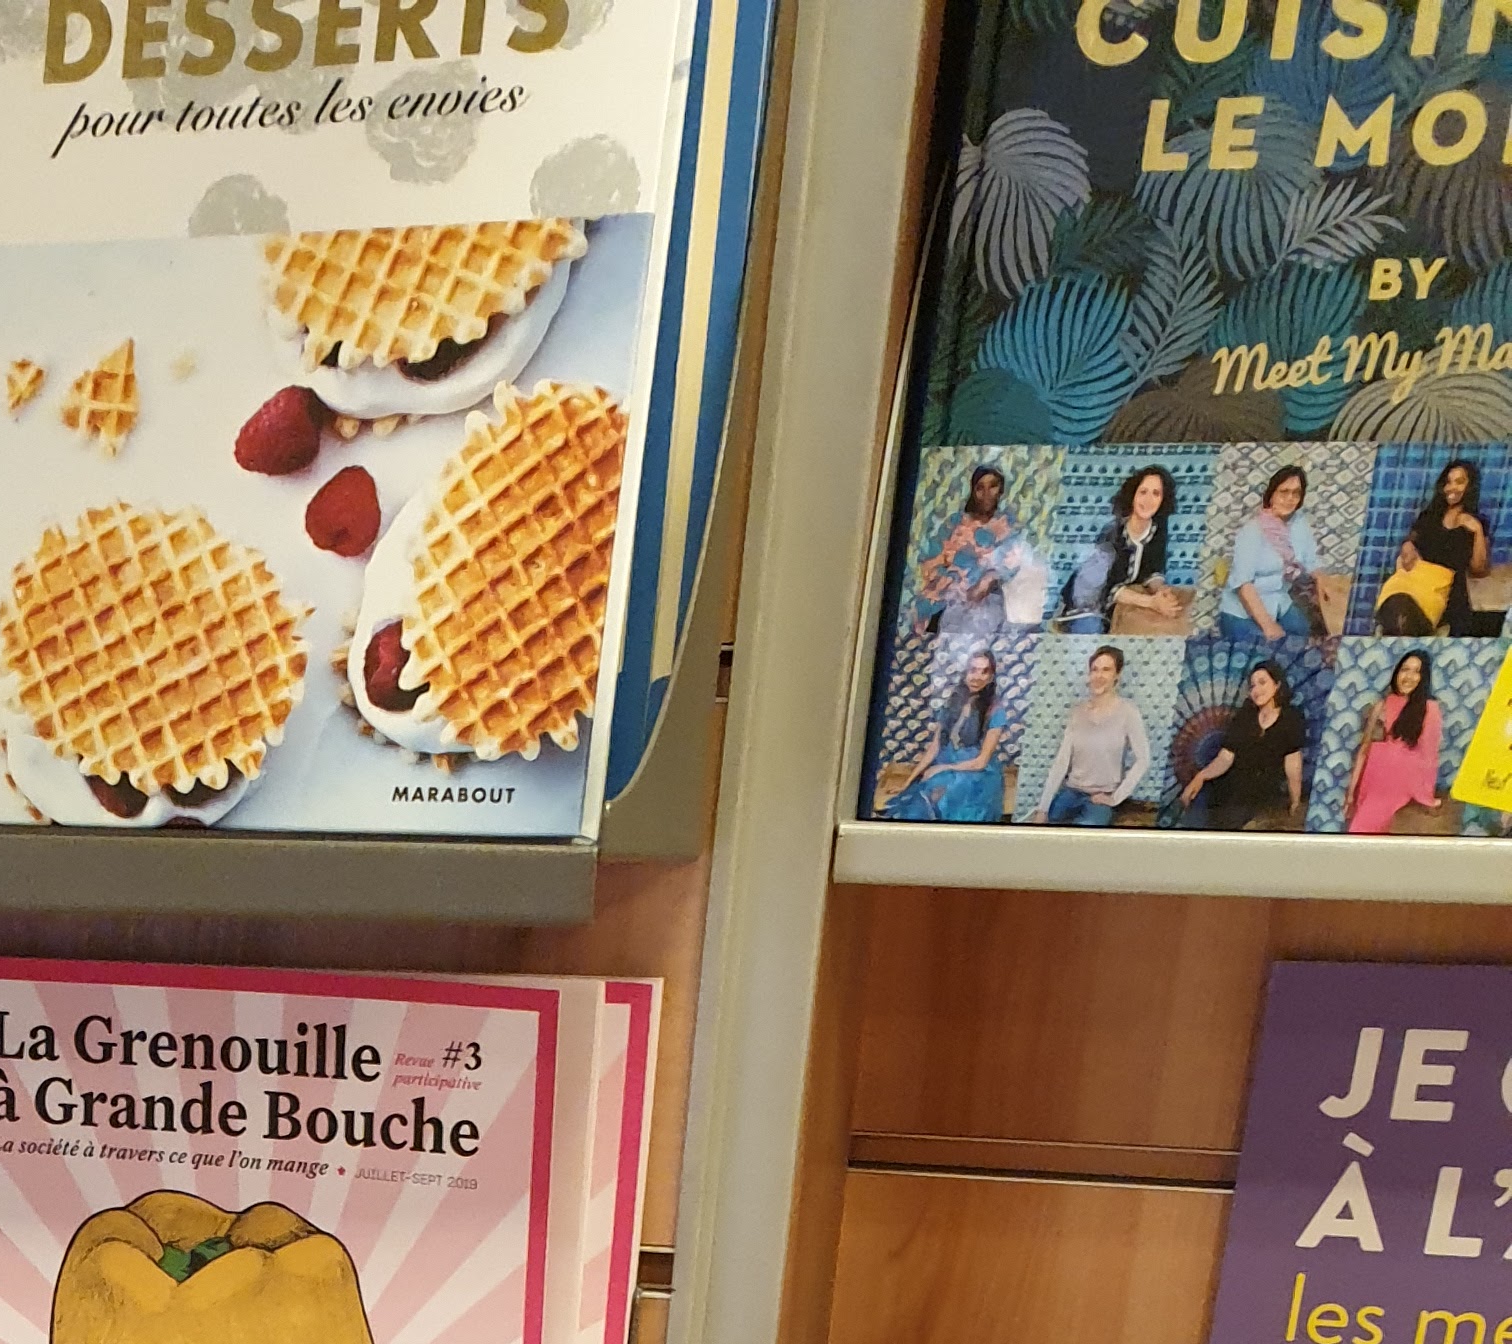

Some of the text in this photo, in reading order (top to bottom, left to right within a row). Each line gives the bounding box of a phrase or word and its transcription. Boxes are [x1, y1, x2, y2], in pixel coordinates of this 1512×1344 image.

[43, 0, 571, 84] DESSERTS
[51, 75, 528, 159] pour toutes les envies
[1141, 96, 1265, 173] LE
[1368, 256, 1447, 302] BY
[1212, 334, 1332, 396] Meet
[1341, 332, 1426, 404] My
[391, 785, 516, 804] MARABOUT
[73, 1014, 382, 1082] Grenouille
[441, 1040, 483, 1071] #3
[1319, 1026, 1469, 1122] JE
[34, 1076, 248, 1138] Grande
[263, 1089, 480, 1157] Bouche
[1295, 1131, 1384, 1252] À
